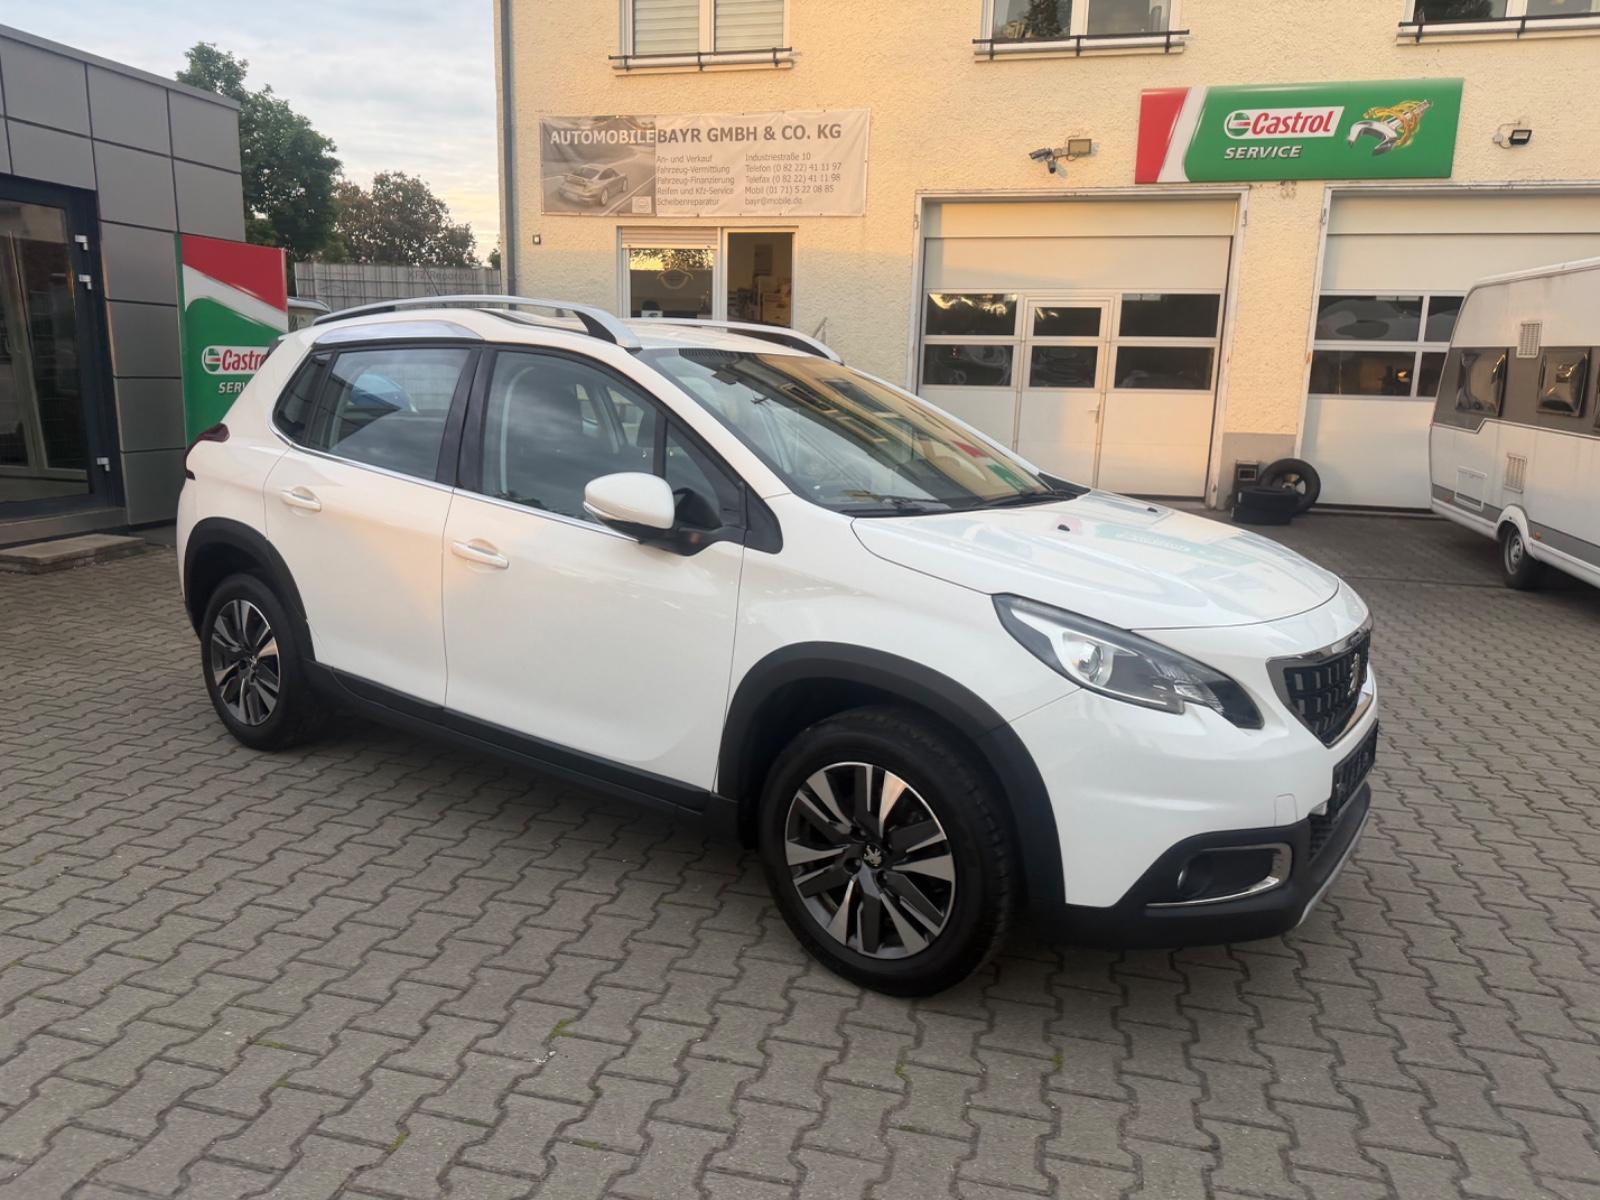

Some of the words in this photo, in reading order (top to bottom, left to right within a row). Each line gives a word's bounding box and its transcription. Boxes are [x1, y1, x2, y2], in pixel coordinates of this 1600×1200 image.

[1252, 110, 1335, 136] Castrol
[550, 129, 656, 145] AUTOMOBILE
[657, 128, 702, 144] BAYR
[707, 126, 758, 142] GMBH
[763, 125, 777, 141] &
[781, 124, 811, 141] CO.
[817, 123, 842, 139] KG
[745, 152, 799, 161] Industriestraße
[802, 152, 811, 161] 10
[1224, 145, 1302, 160] SERVICE
[671, 155, 685, 163] und
[687, 154, 713, 163] Verkauf
[745, 163, 771, 173] Telefon
[783, 163, 792, 172] 82
[794, 162, 807, 173] 22)
[809, 162, 818, 171] 41
[821, 162, 829, 171] 11
[832, 161, 842, 171] 97
[745, 175, 770, 184] Telefax
[782, 174, 792, 183] 82
[794, 174, 806, 184] 22)
[808, 174, 817, 183] 41
[820, 173, 829, 182] 11
[657, 187, 679, 195] Reifen
[680, 187, 693, 195] und
[695, 186, 734, 195] Kfz-Service
[744, 186, 764, 195] Mobil
[780, 185, 793, 195] 71)
[801, 185, 811, 194] 22
[222, 349, 269, 372] Castro
